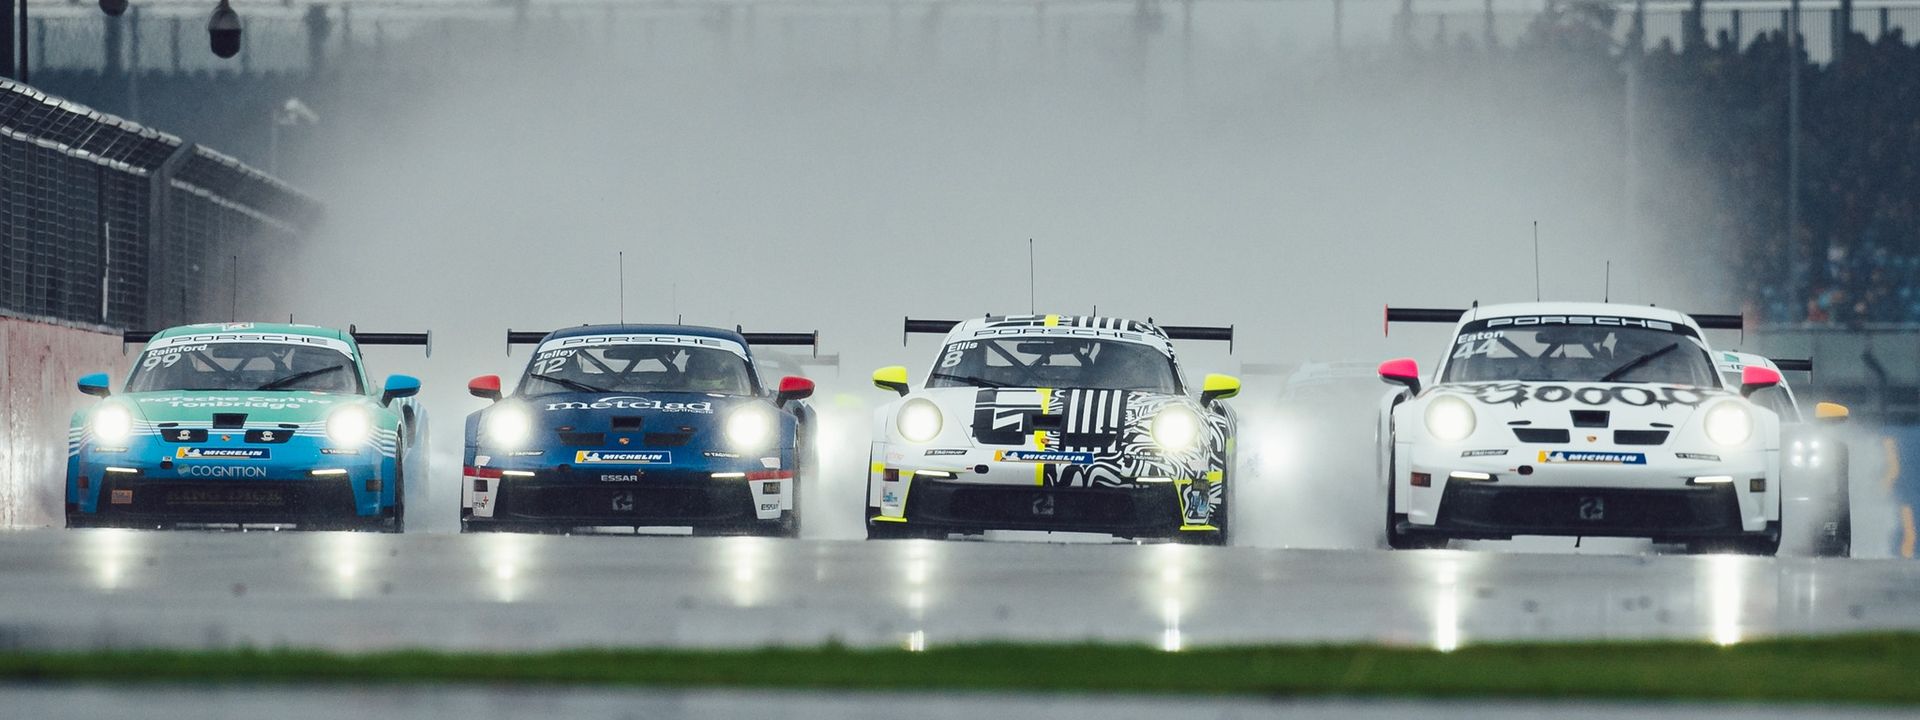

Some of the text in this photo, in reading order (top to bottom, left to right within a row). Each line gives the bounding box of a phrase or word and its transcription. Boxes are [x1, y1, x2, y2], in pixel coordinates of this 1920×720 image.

[1487, 316, 1673, 331] PORSCHE
[171, 335, 327, 344] PORSCHE
[974, 328, 1143, 341] PORSCHE
[1457, 330, 1504, 344] Eaton
[563, 336, 721, 346] PORSCHE
[947, 341, 979, 353] Ellis
[147, 344, 207, 357] Rainford
[1452, 338, 1498, 359] 44
[537, 349, 577, 361] Jelley
[941, 350, 964, 368] 8
[142, 352, 182, 372] 99
[534, 357, 567, 375] 12
[169, 401, 301, 410] Tonbridge
[247, 396, 332, 404] Centre
[545, 400, 712, 412] metclad
[203, 448, 263, 456] MICHELIN
[1022, 453, 1086, 462] MICHELIN
[1568, 453, 1637, 462] MICHELIN
[191, 465, 267, 478] COGNITION
[601, 474, 638, 482] ESSAR
